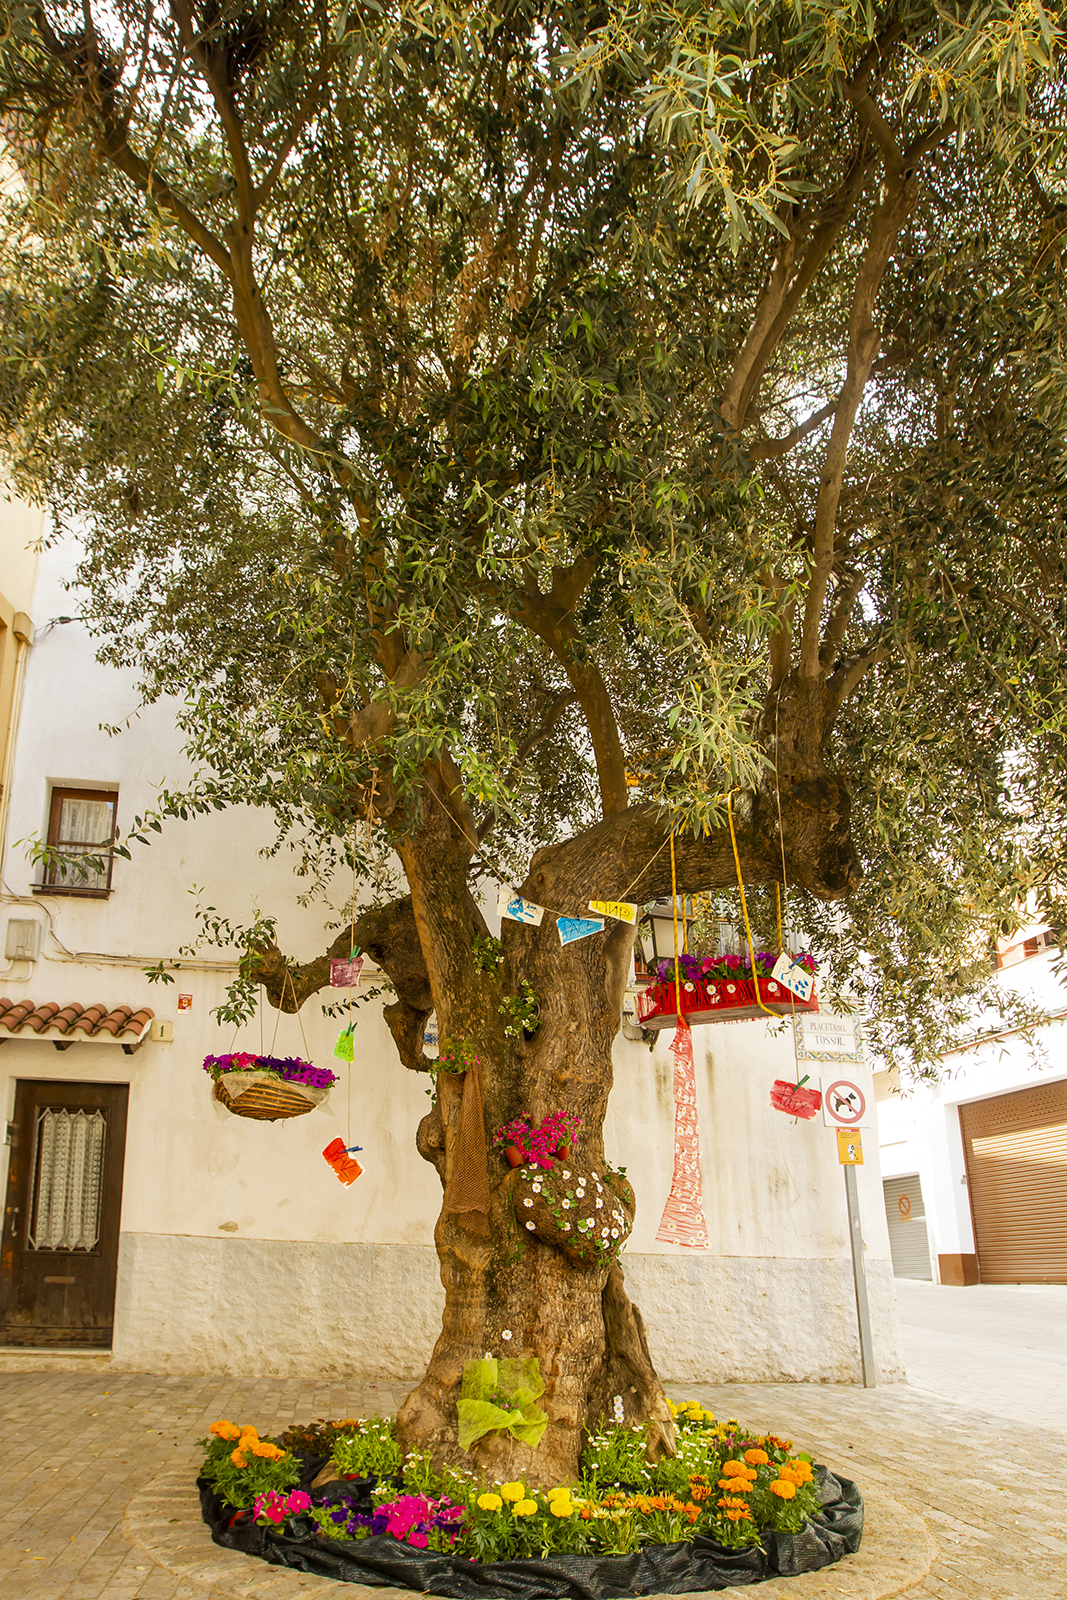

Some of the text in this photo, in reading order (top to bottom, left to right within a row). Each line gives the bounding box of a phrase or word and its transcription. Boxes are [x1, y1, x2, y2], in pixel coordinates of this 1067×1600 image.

[560, 920, 597, 939] PACE
[160, 1024, 165, 1038] 1
[809, 1021, 837, 1031] PLACETA
[814, 1034, 846, 1046] TOSSOL
[777, 1084, 807, 1113] Paix
[330, 1144, 358, 1178] PAZ
